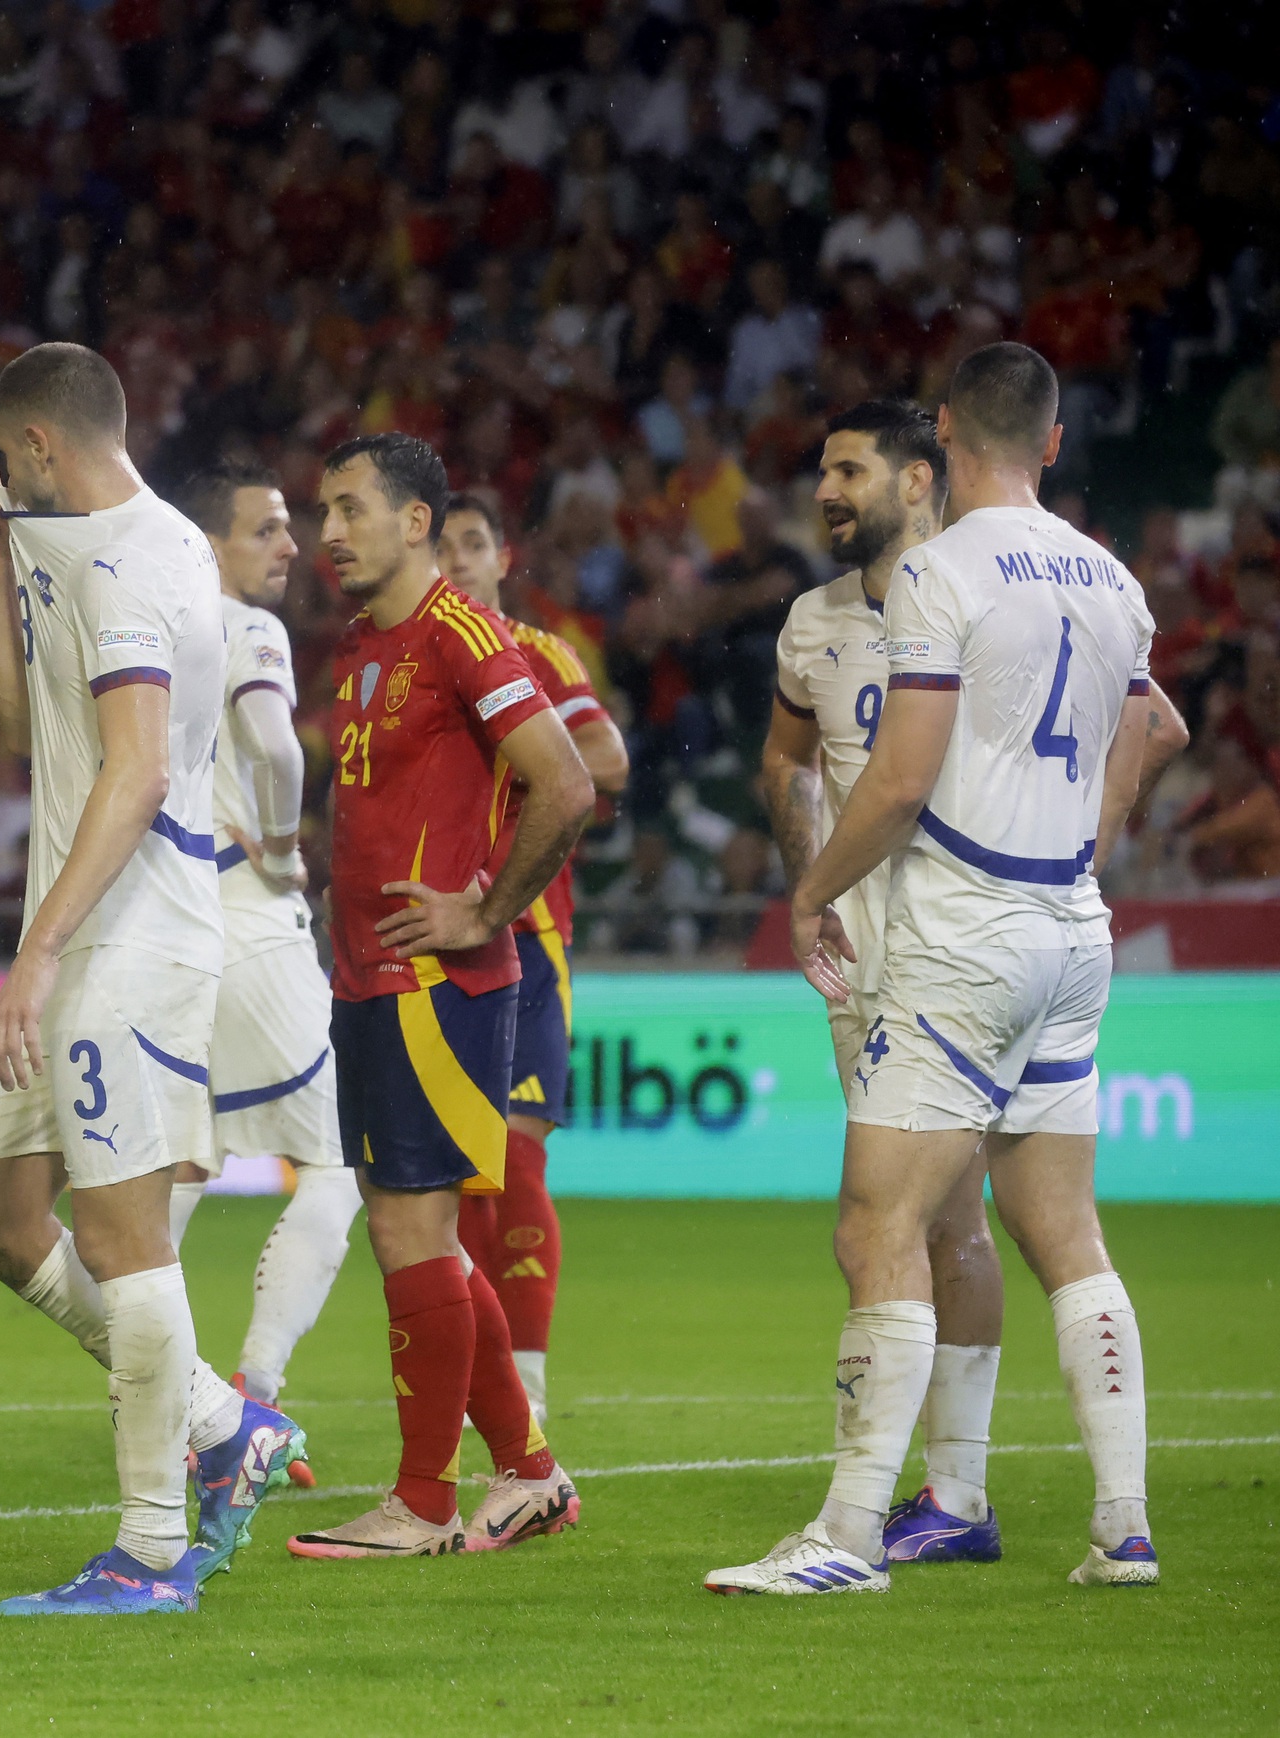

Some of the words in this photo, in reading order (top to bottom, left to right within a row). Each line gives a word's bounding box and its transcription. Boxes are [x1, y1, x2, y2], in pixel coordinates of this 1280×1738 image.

[98, 633, 158, 644] FOUNDATION
[479, 683, 532, 713] FOUNDATION
[855, 684, 882, 752] 9
[1031, 616, 1078, 783] 4
[340, 721, 373, 787] 21
[864, 1014, 890, 1065] 4
[69, 1040, 107, 1120] 3
